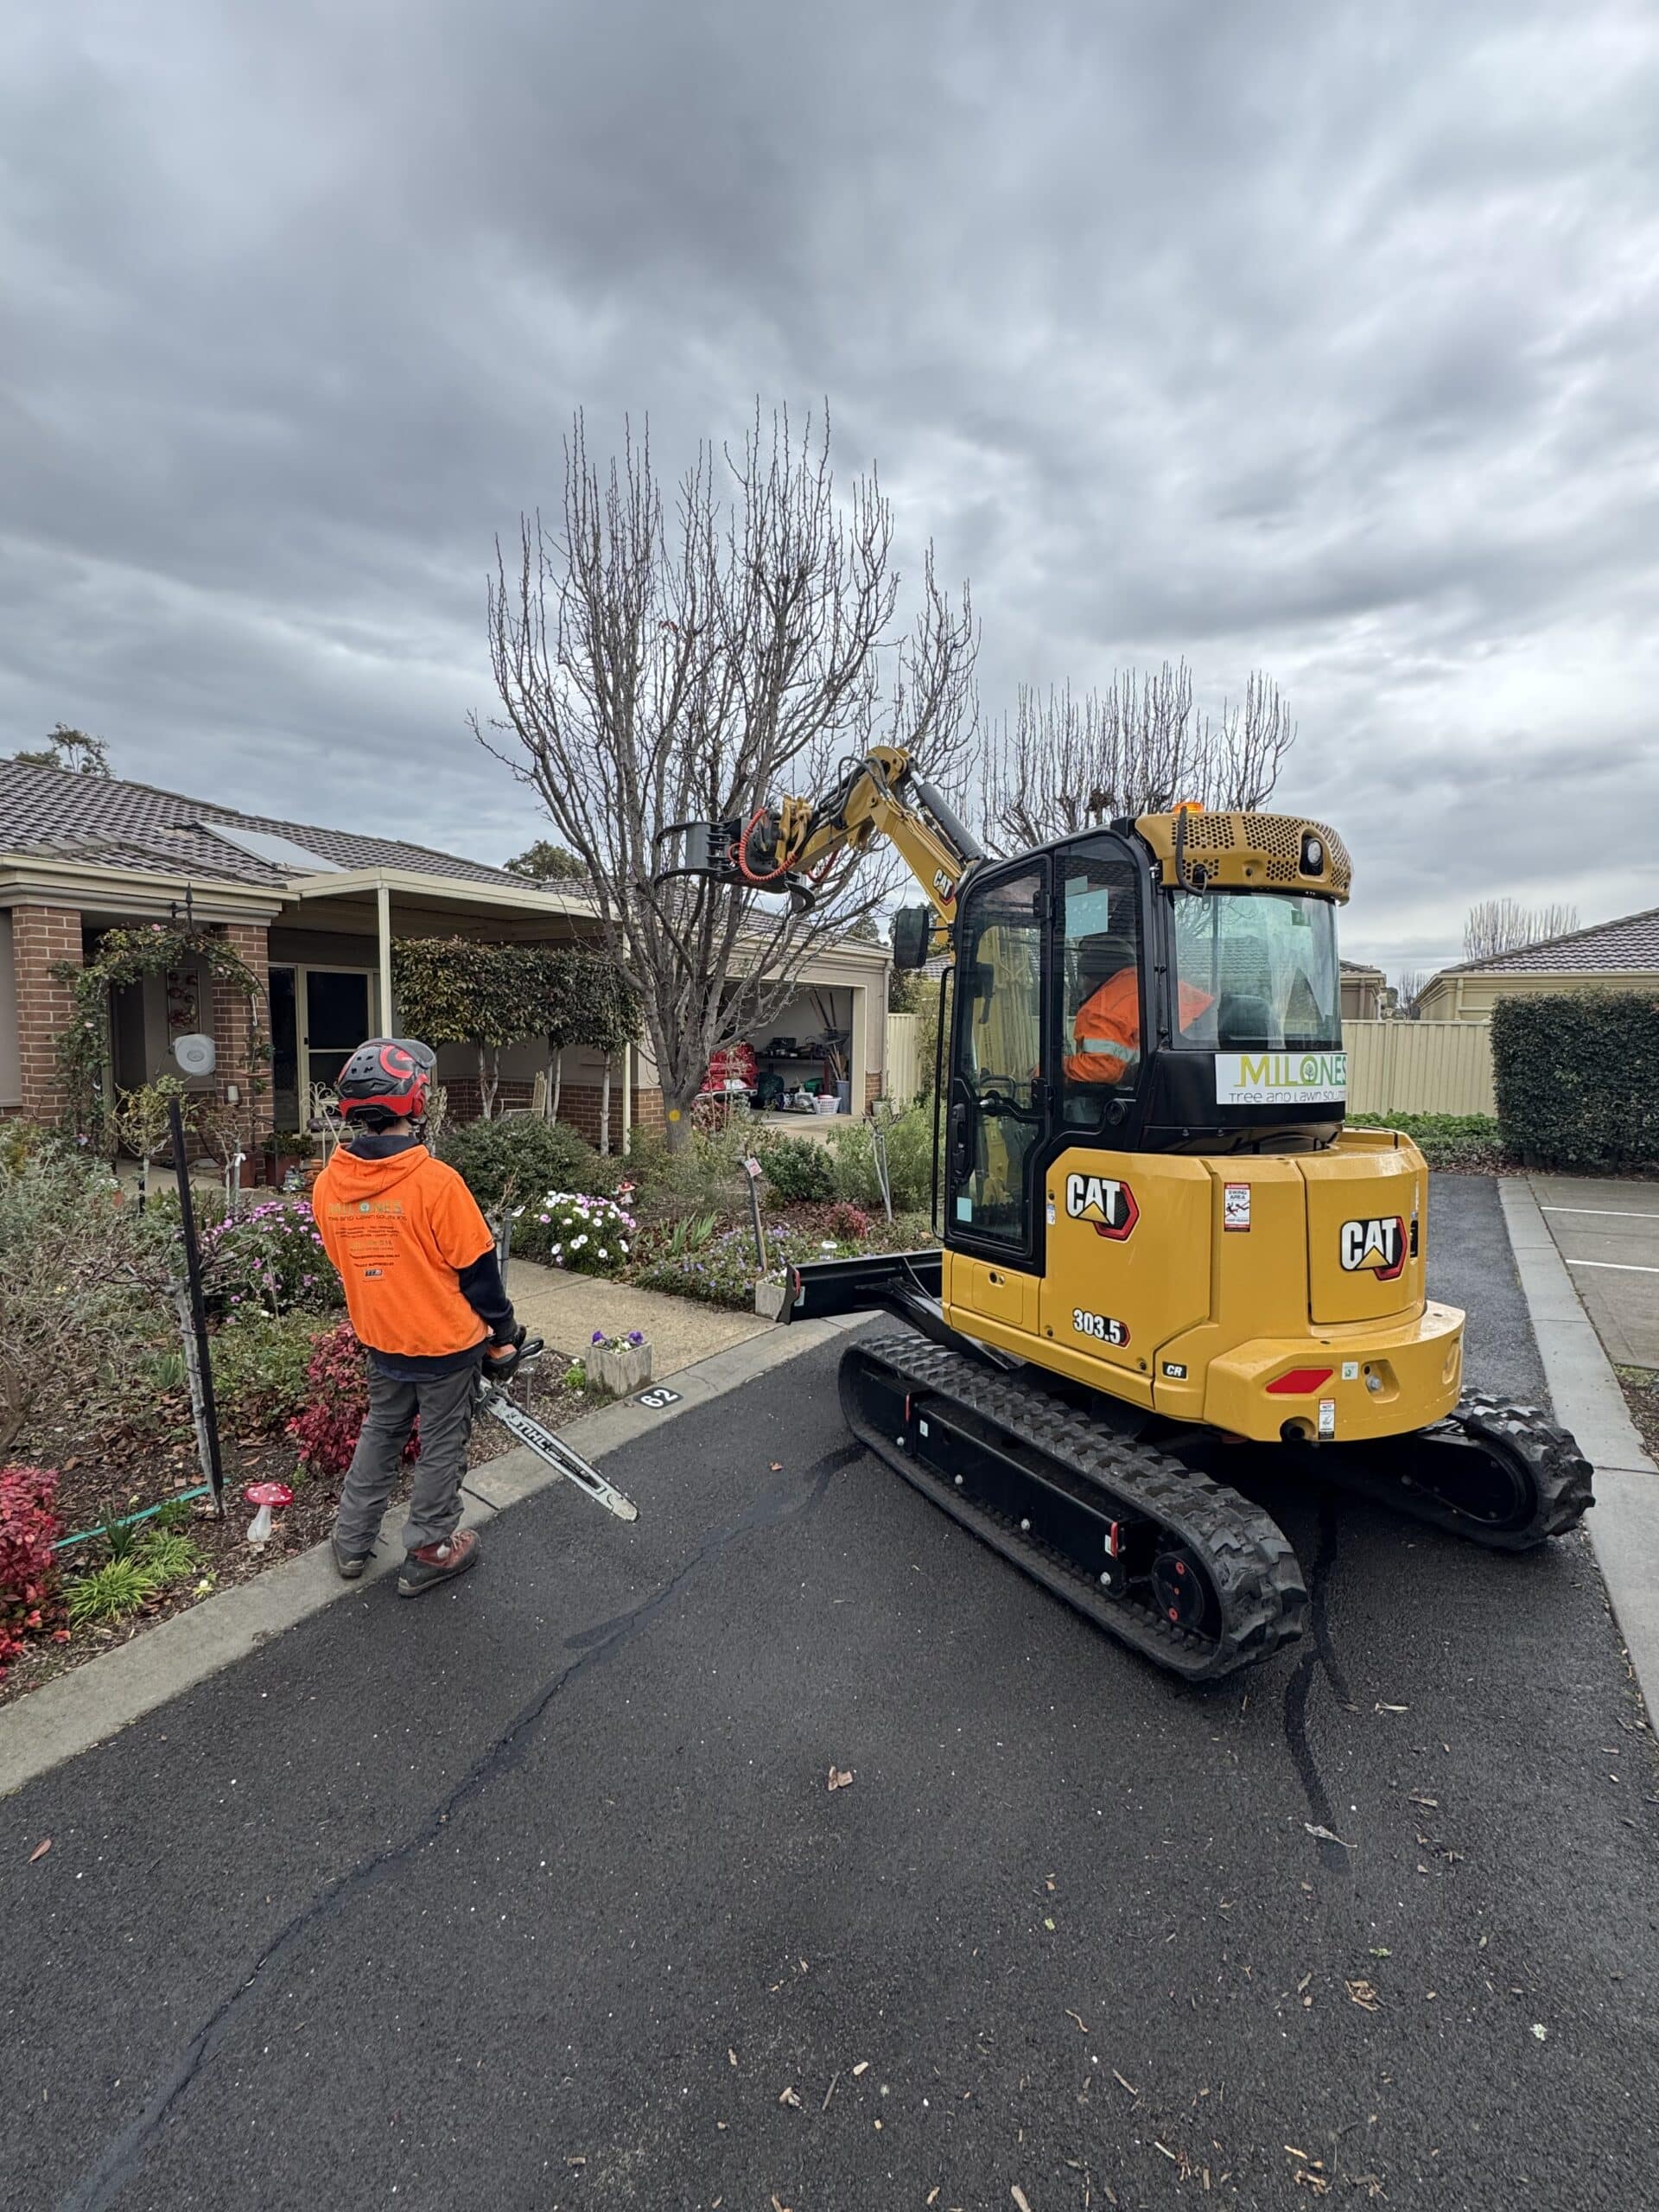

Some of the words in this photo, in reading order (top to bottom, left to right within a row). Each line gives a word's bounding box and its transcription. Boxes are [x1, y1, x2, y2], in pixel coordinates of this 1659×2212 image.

[933, 868, 953, 899] CAT
[1234, 1054, 1346, 1087] MILONES
[1067, 1174, 1121, 1225] CAT
[1341, 1217, 1397, 1270] CAT
[1073, 1308, 1121, 1344] 303.5
[1166, 1364, 1183, 1376] CR
[640, 1389, 678, 1407] 62
[508, 1415, 549, 1450] STIHL
